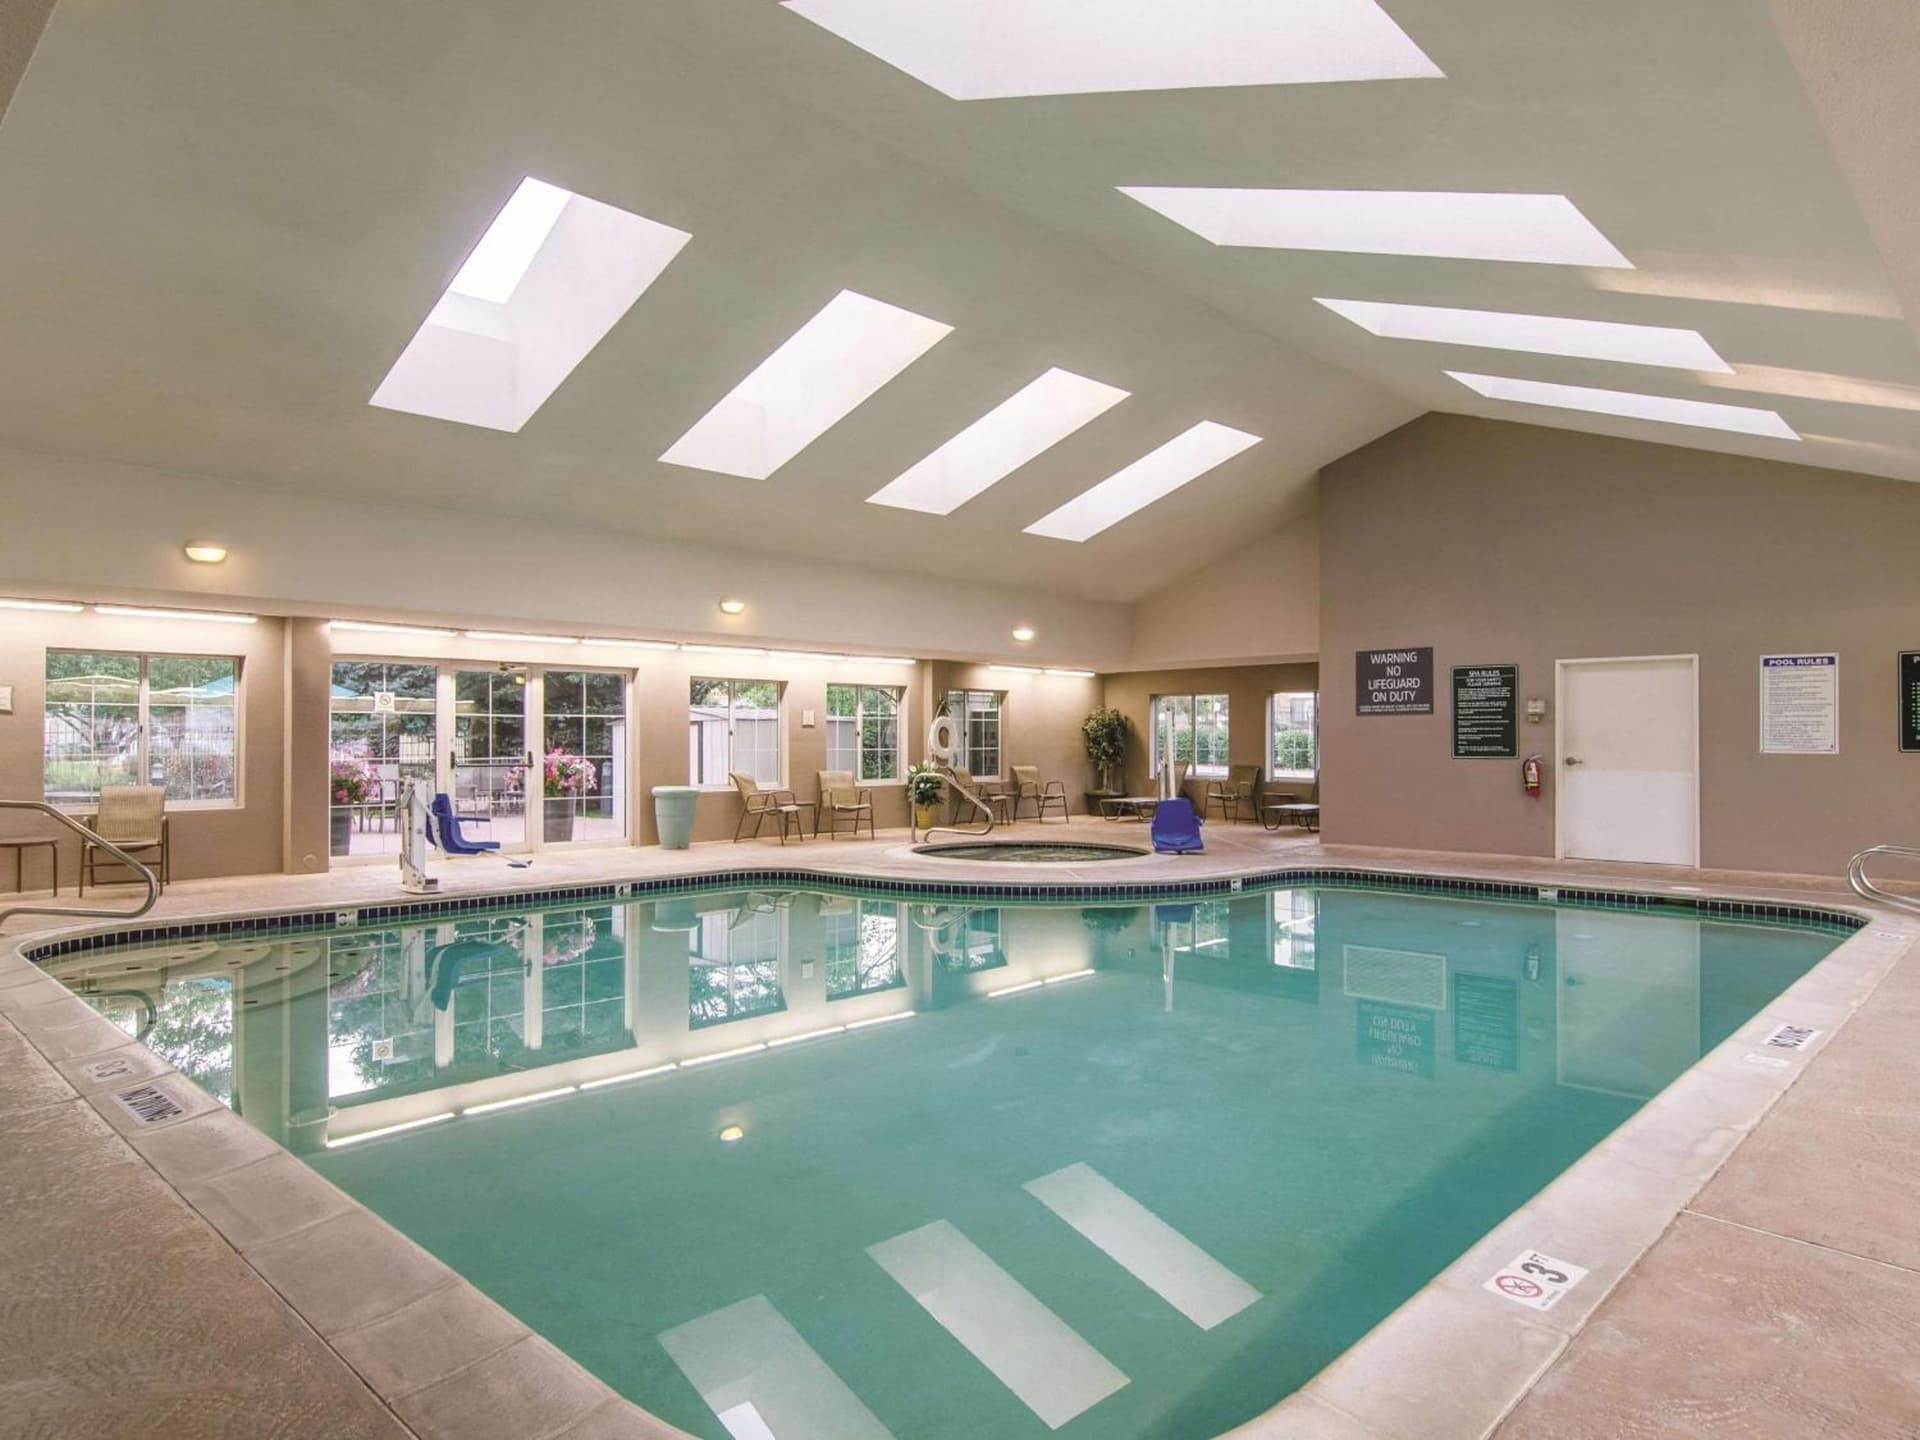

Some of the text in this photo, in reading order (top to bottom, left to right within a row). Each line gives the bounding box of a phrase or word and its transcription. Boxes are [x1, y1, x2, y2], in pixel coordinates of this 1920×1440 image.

[1370, 652, 1418, 664] WARNING
[1386, 665, 1401, 676] NO
[1368, 678, 1421, 690] LIFEGUARD
[1372, 690, 1416, 702] ON DUTY
[1521, 1263, 1569, 1284] 3
